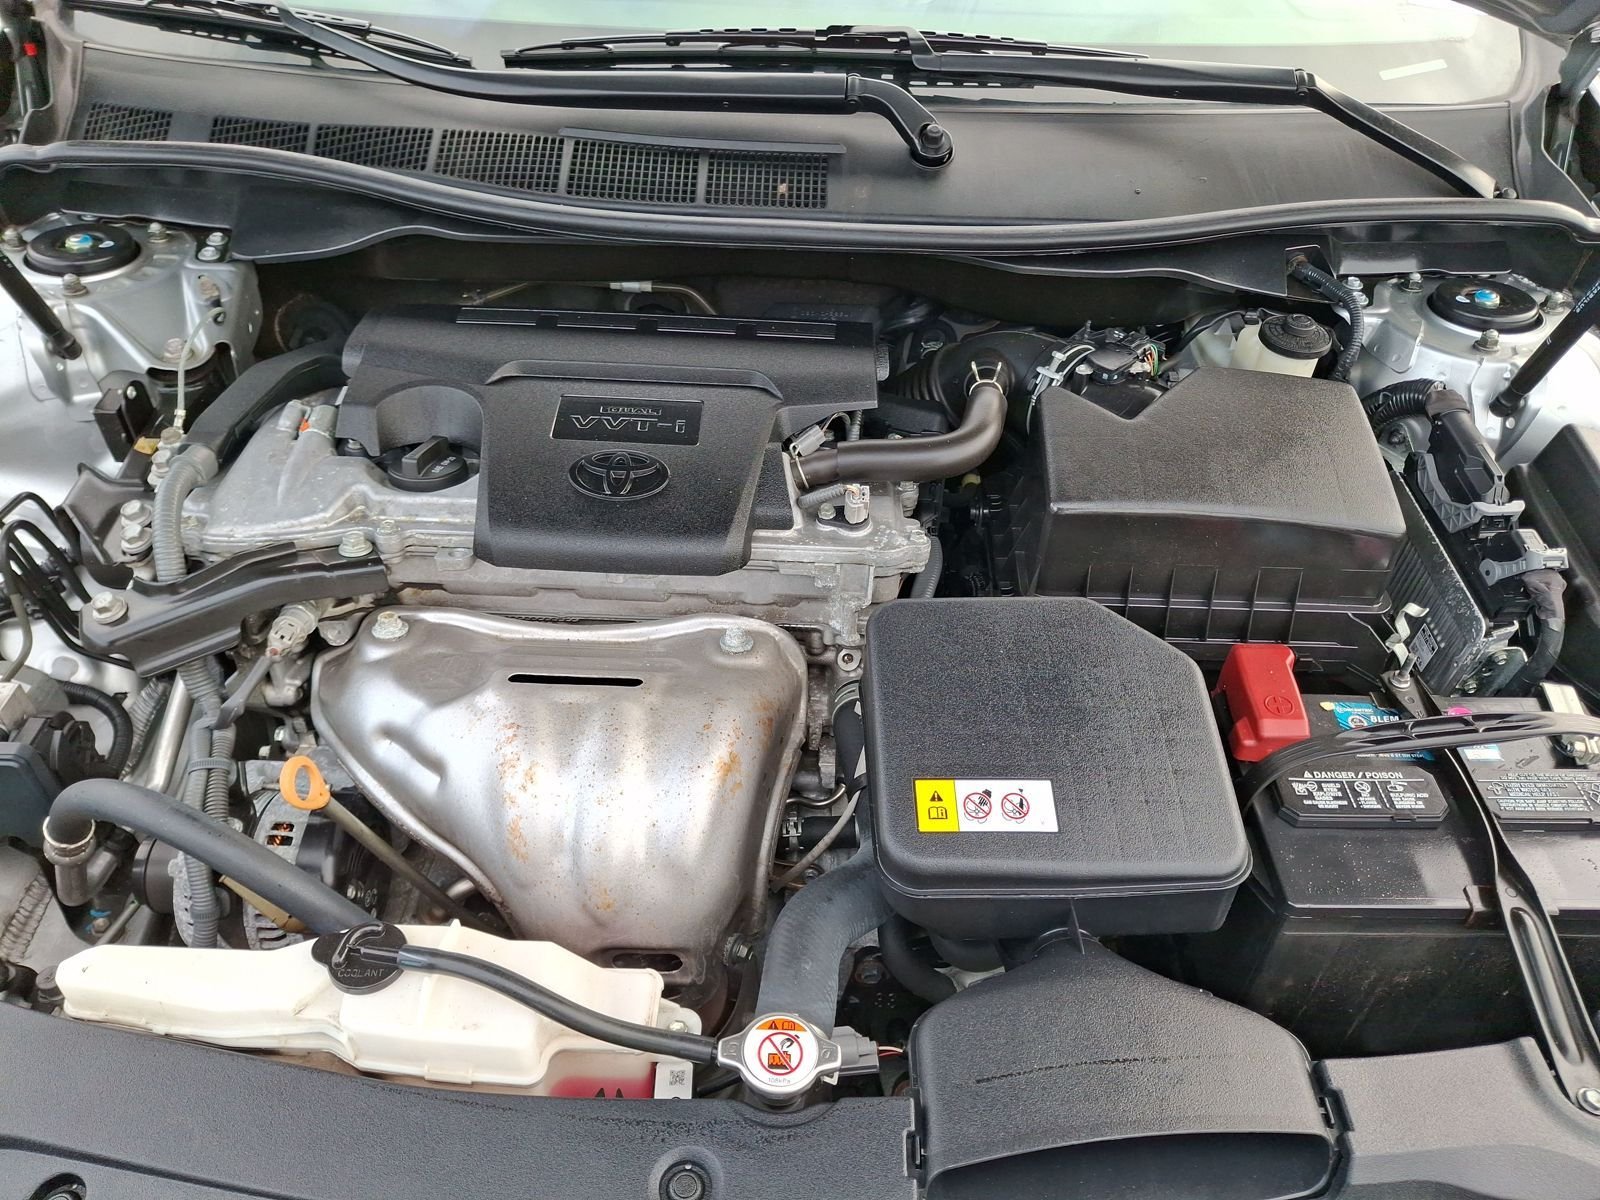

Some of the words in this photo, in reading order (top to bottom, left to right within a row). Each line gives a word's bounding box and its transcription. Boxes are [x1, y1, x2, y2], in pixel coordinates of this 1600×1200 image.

[570, 415, 686, 433] VVT-i
[1370, 715, 1400, 723] BLEM
[1313, 771, 1356, 779] DANGER
[1365, 771, 1404, 779] POISON
[337, 968, 385, 978] COOLANT
